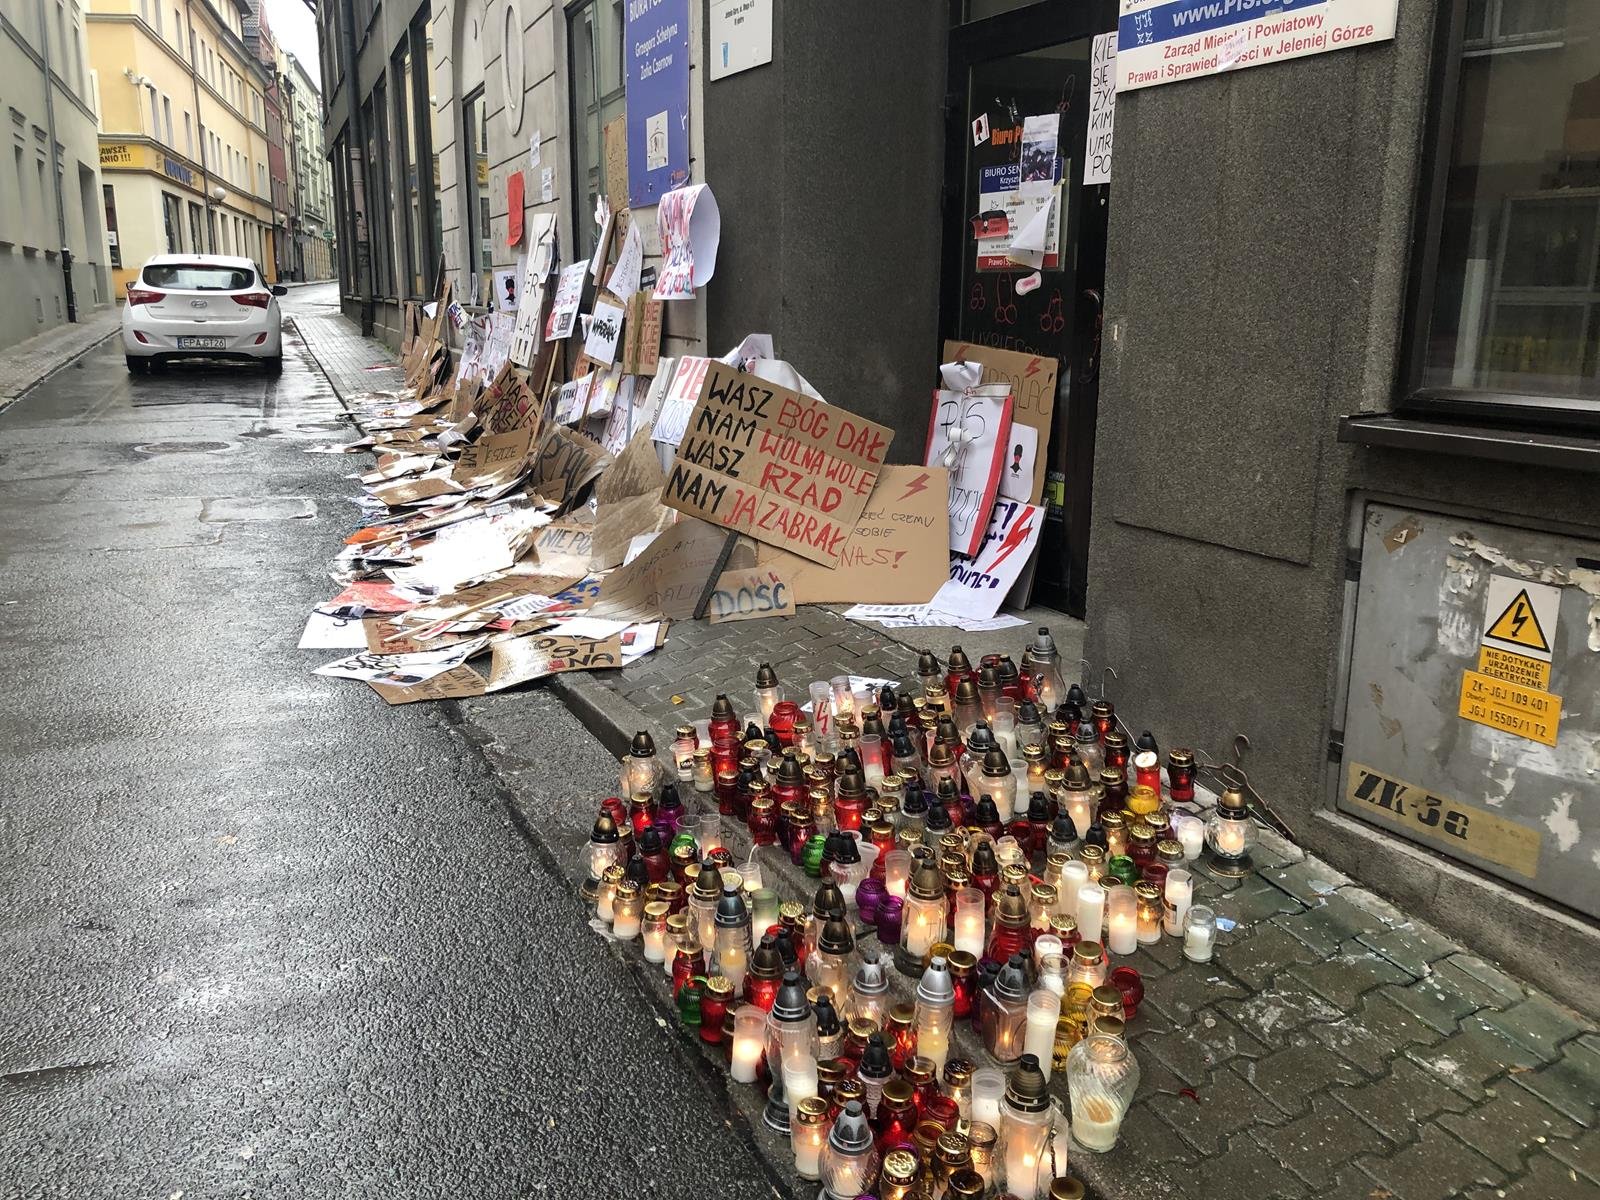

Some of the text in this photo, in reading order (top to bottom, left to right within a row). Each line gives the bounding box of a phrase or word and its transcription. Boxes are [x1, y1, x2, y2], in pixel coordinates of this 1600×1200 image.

[1164, 40, 1201, 59] Zarząd
[1254, 14, 1325, 39] Powiatowy
[1127, 69, 1158, 85] Prawa
[1160, 65, 1165, 78] i
[1262, 45, 1274, 58] w
[1276, 31, 1328, 55] Jeleniej
[1331, 24, 1375, 43] Górze
[1091, 109, 1113, 132] KIM
[984, 166, 1007, 178] BIURO
[696, 405, 757, 447] NAM
[708, 371, 774, 419] WASZ
[777, 398, 829, 440] BÓG
[836, 421, 886, 464] DAŁ
[684, 436, 746, 478] WASZ
[666, 464, 729, 514] NAM
[757, 501, 847, 558] ZABRAŁ
[854, 528, 896, 538] SOBIE
[1486, 650, 1499, 659] NIE
[1484, 666, 1543, 689] ELEKTRYCZNE
[1511, 692, 1528, 706] 109
[1468, 704, 1486, 719] JGJ
